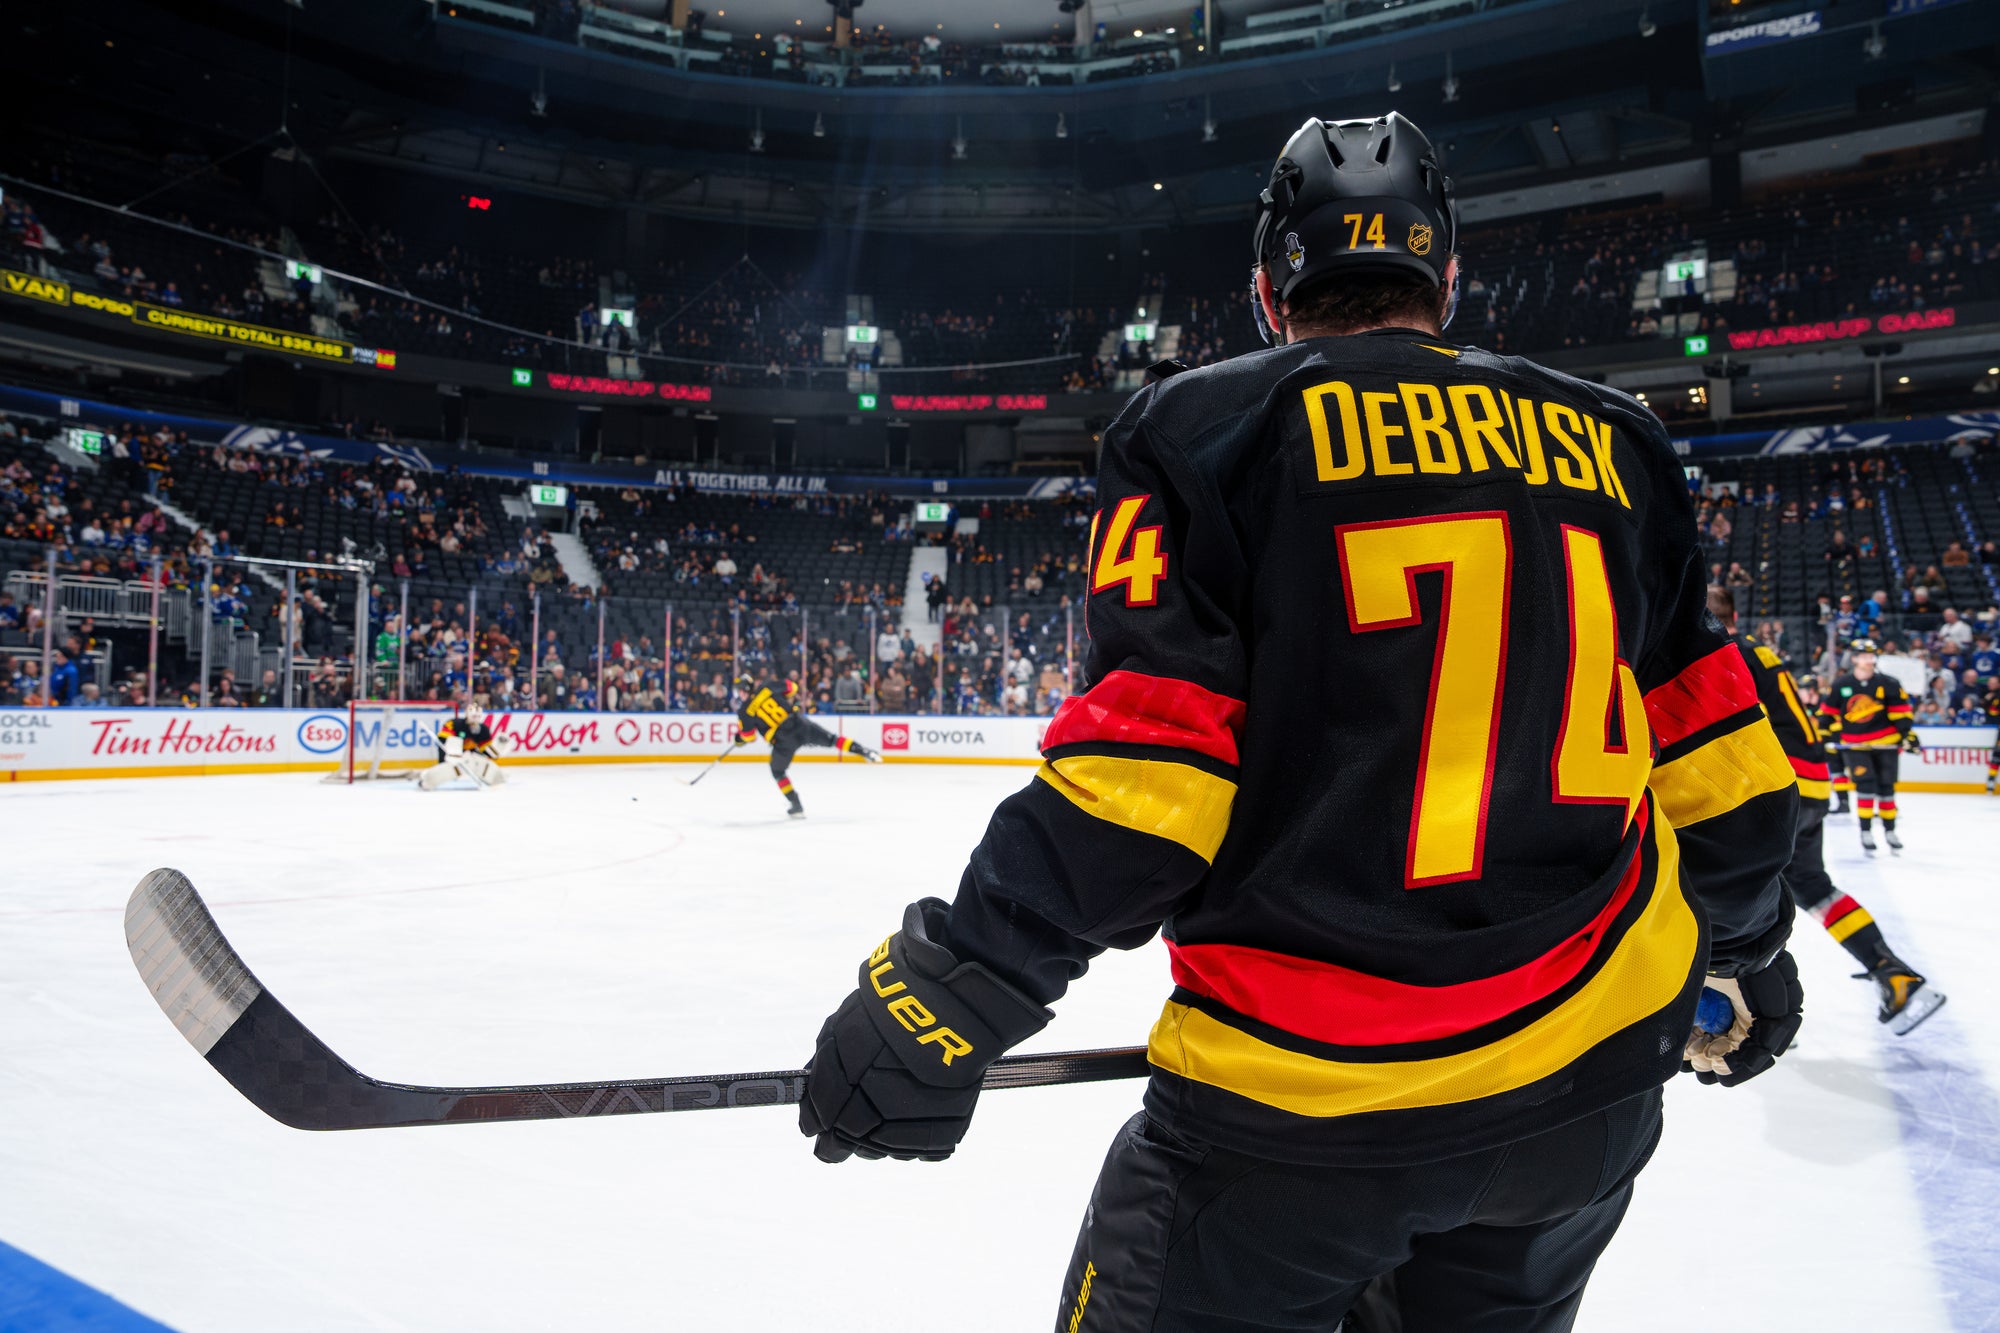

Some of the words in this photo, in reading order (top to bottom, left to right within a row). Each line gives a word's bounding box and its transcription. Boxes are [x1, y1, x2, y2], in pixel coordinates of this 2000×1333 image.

[1343, 213, 1386, 250] 74
[1412, 234, 1429, 248] NHL
[7, 274, 64, 301] VAN
[147, 310, 225, 336] CURRENT
[514, 369, 531, 385] TD
[860, 395, 876, 409] TD
[655, 470, 683, 486] ALL
[776, 477, 804, 491] ALL
[1087, 494, 1169, 620] 4
[1334, 510, 1656, 889] 74
[0, 714, 52, 729] OCAL
[756, 697, 788, 743] 18
[90, 719, 151, 755] Tim
[157, 718, 277, 754] Hortons
[306, 725, 342, 741] Esso
[650, 722, 739, 743] ROGER
[916, 730, 985, 744] TOYOTA
